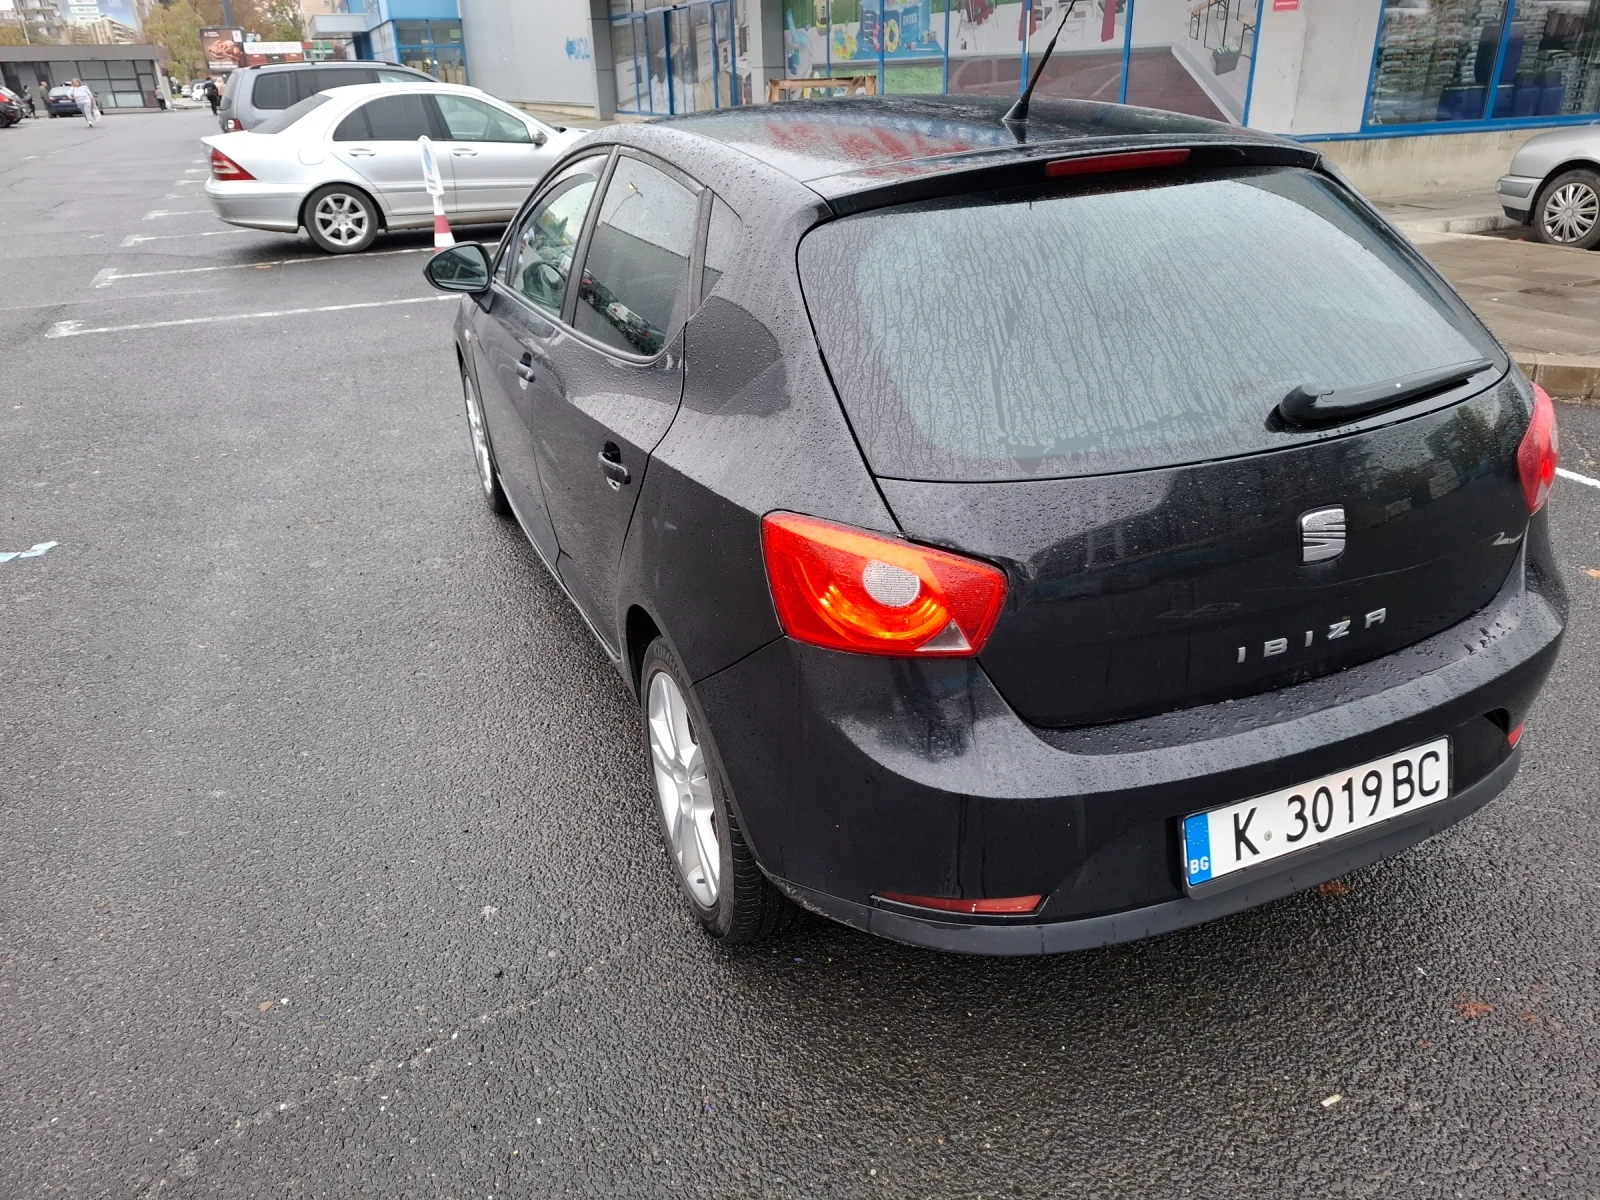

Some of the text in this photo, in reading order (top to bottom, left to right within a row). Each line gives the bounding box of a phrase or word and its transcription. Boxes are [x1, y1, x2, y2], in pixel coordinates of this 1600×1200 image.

[1237, 607, 1387, 663] IBIZA
[1233, 750, 1441, 861] K 3019 BC
[1189, 856, 1209, 875] BG
